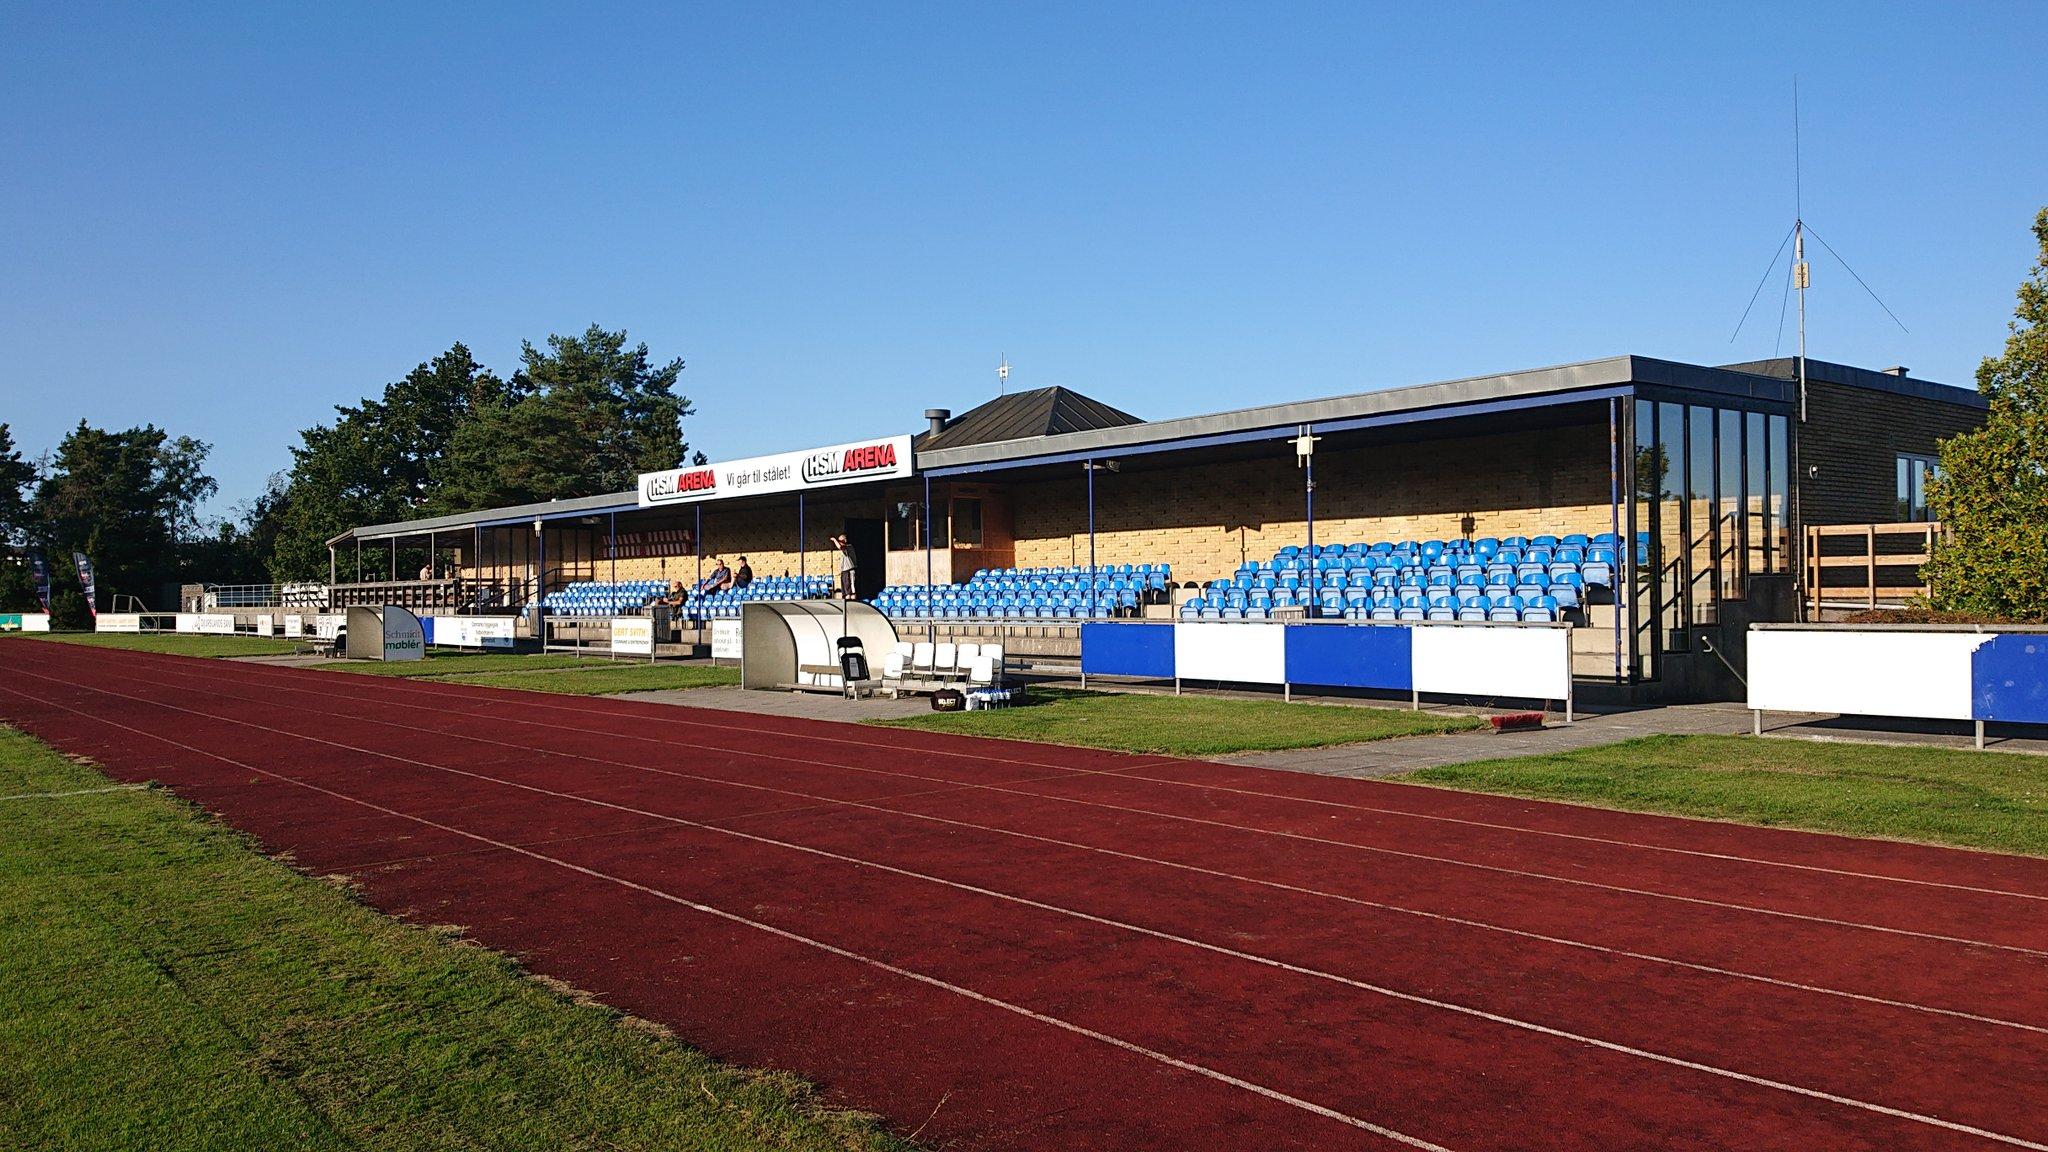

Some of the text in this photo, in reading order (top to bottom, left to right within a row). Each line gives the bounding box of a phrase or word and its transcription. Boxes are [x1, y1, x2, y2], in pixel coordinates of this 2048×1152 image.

[806, 443, 898, 477] HSM ARENA
[650, 469, 717, 497] HSM ARENA
[726, 464, 791, 489] Vi går til stålet!
[385, 630, 421, 639] Schmidt
